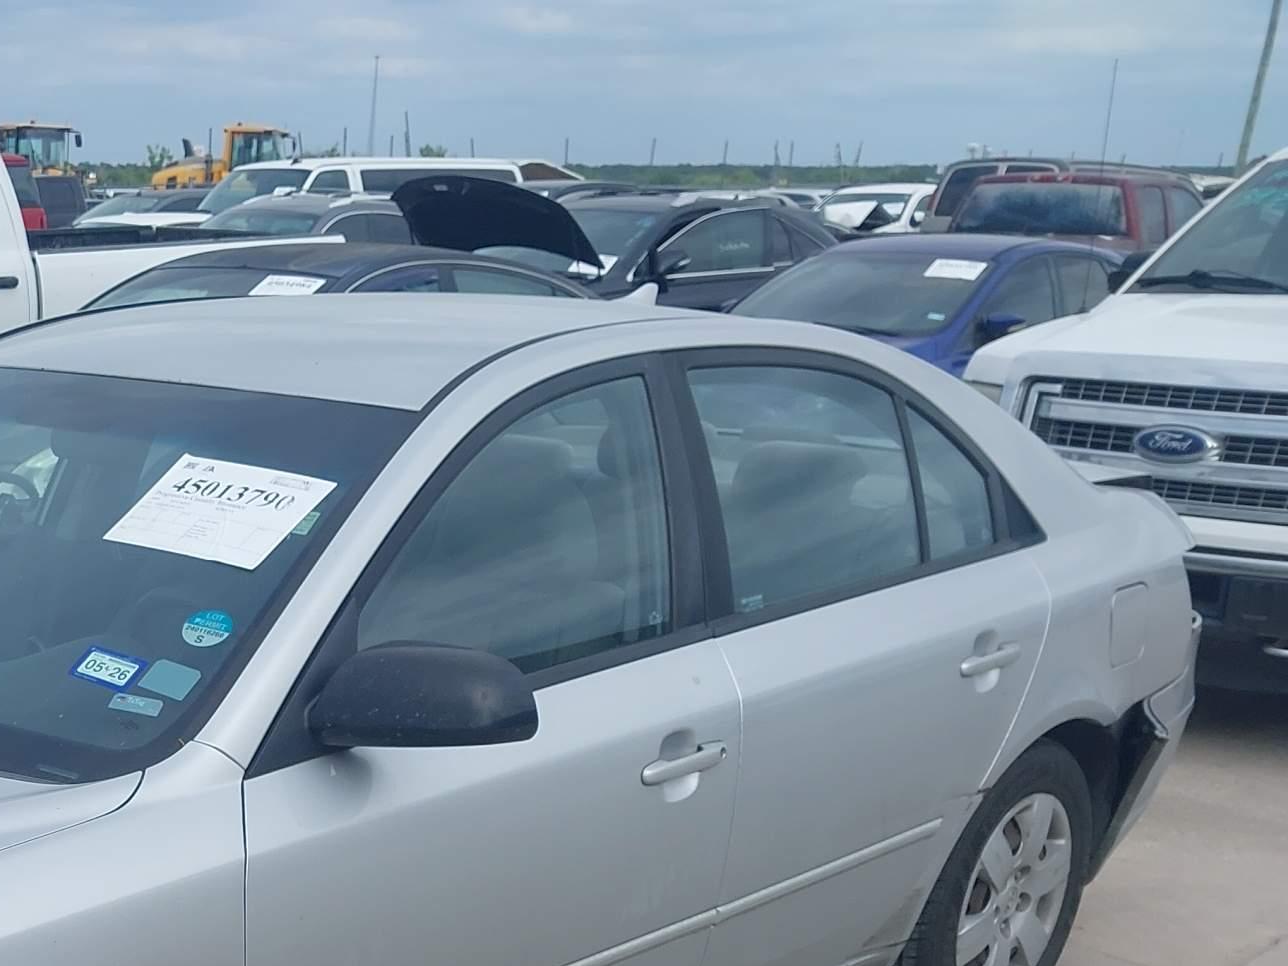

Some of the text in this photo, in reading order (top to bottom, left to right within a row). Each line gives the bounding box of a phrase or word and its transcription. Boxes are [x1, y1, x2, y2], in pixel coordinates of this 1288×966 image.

[1148, 431, 1193, 451] Ford
[172, 476, 296, 511] 45013790
[194, 634, 205, 644] S
[84, 659, 107, 673] 05
[107, 666, 131, 681] 26
